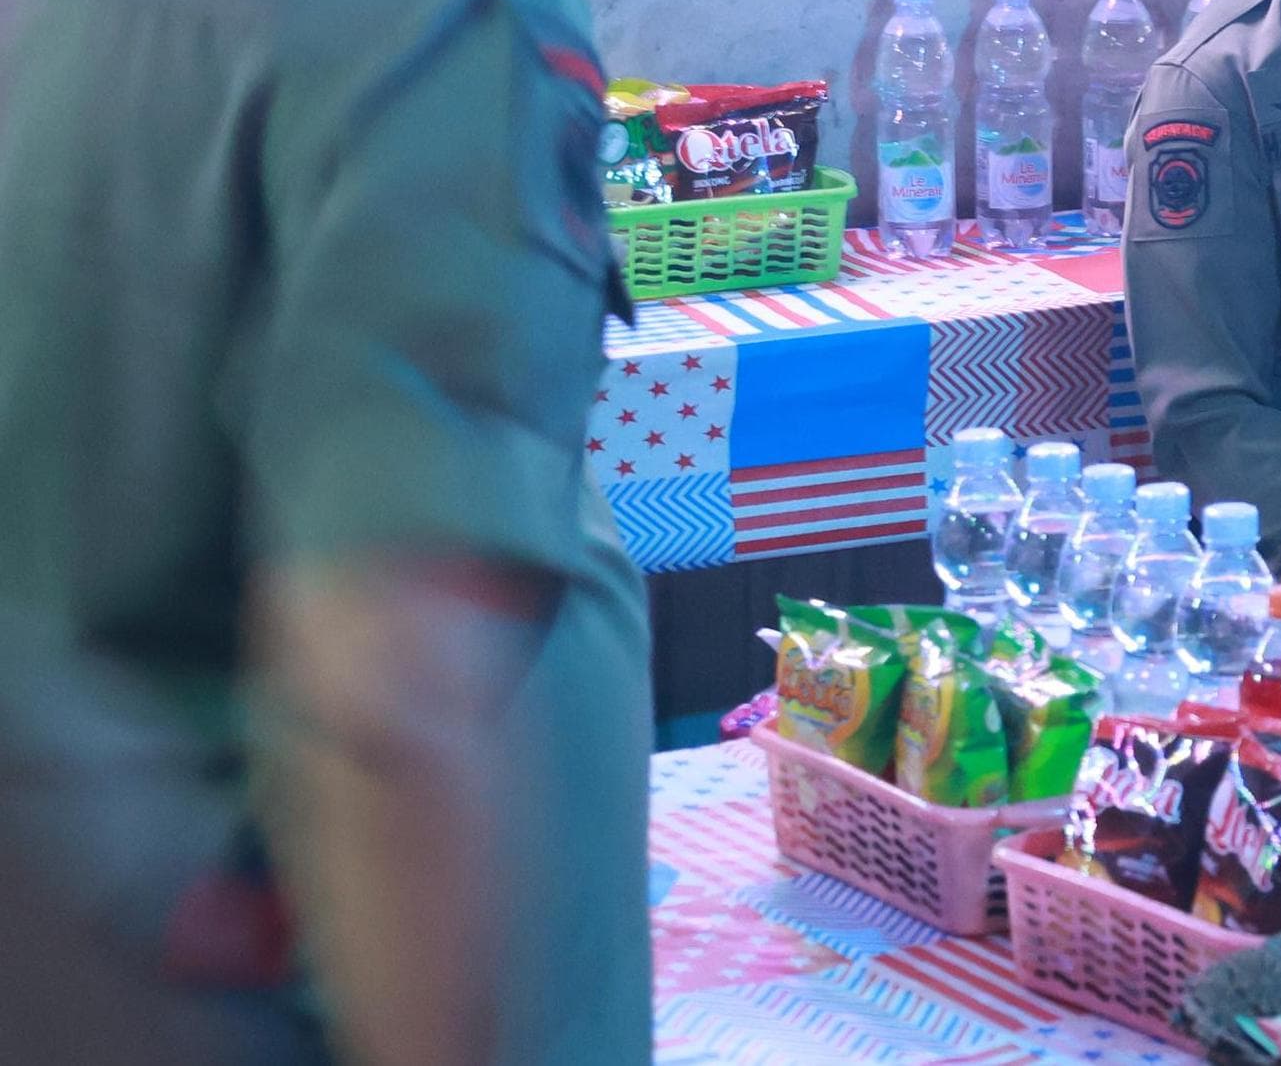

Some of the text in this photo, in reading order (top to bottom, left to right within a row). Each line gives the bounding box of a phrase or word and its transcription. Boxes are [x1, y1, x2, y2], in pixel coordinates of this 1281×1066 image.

[676, 117, 797, 174] Qtela
[1019, 163, 1035, 175] Le
[910, 176, 926, 188] Le
